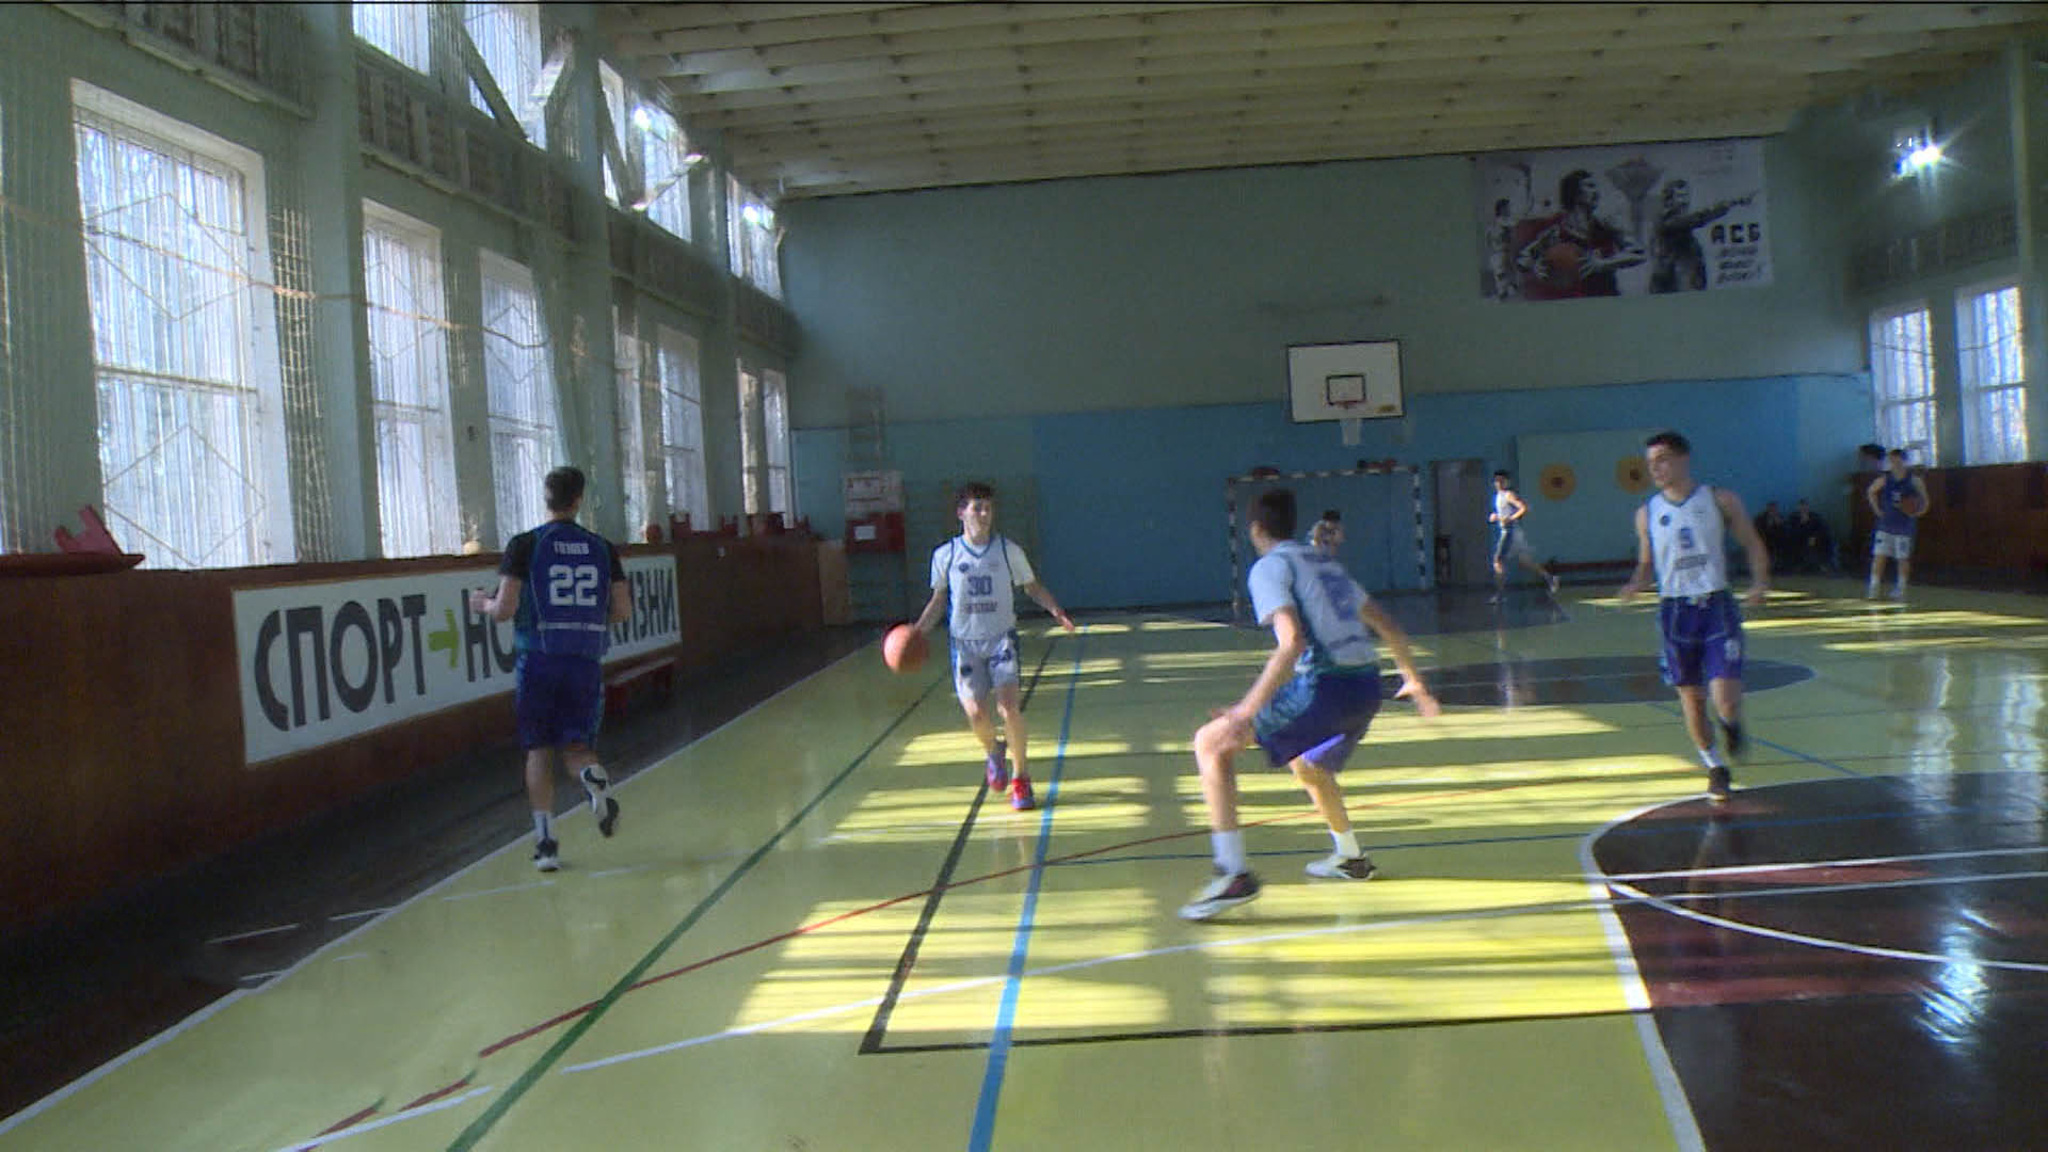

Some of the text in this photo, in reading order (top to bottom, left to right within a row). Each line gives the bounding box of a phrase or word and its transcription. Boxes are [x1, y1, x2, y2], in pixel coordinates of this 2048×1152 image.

[549, 564, 598, 606] 22
[967, 575, 993, 597] 30
[254, 593, 427, 732] СПОРТ
[613, 568, 677, 646] ИЗНИ
